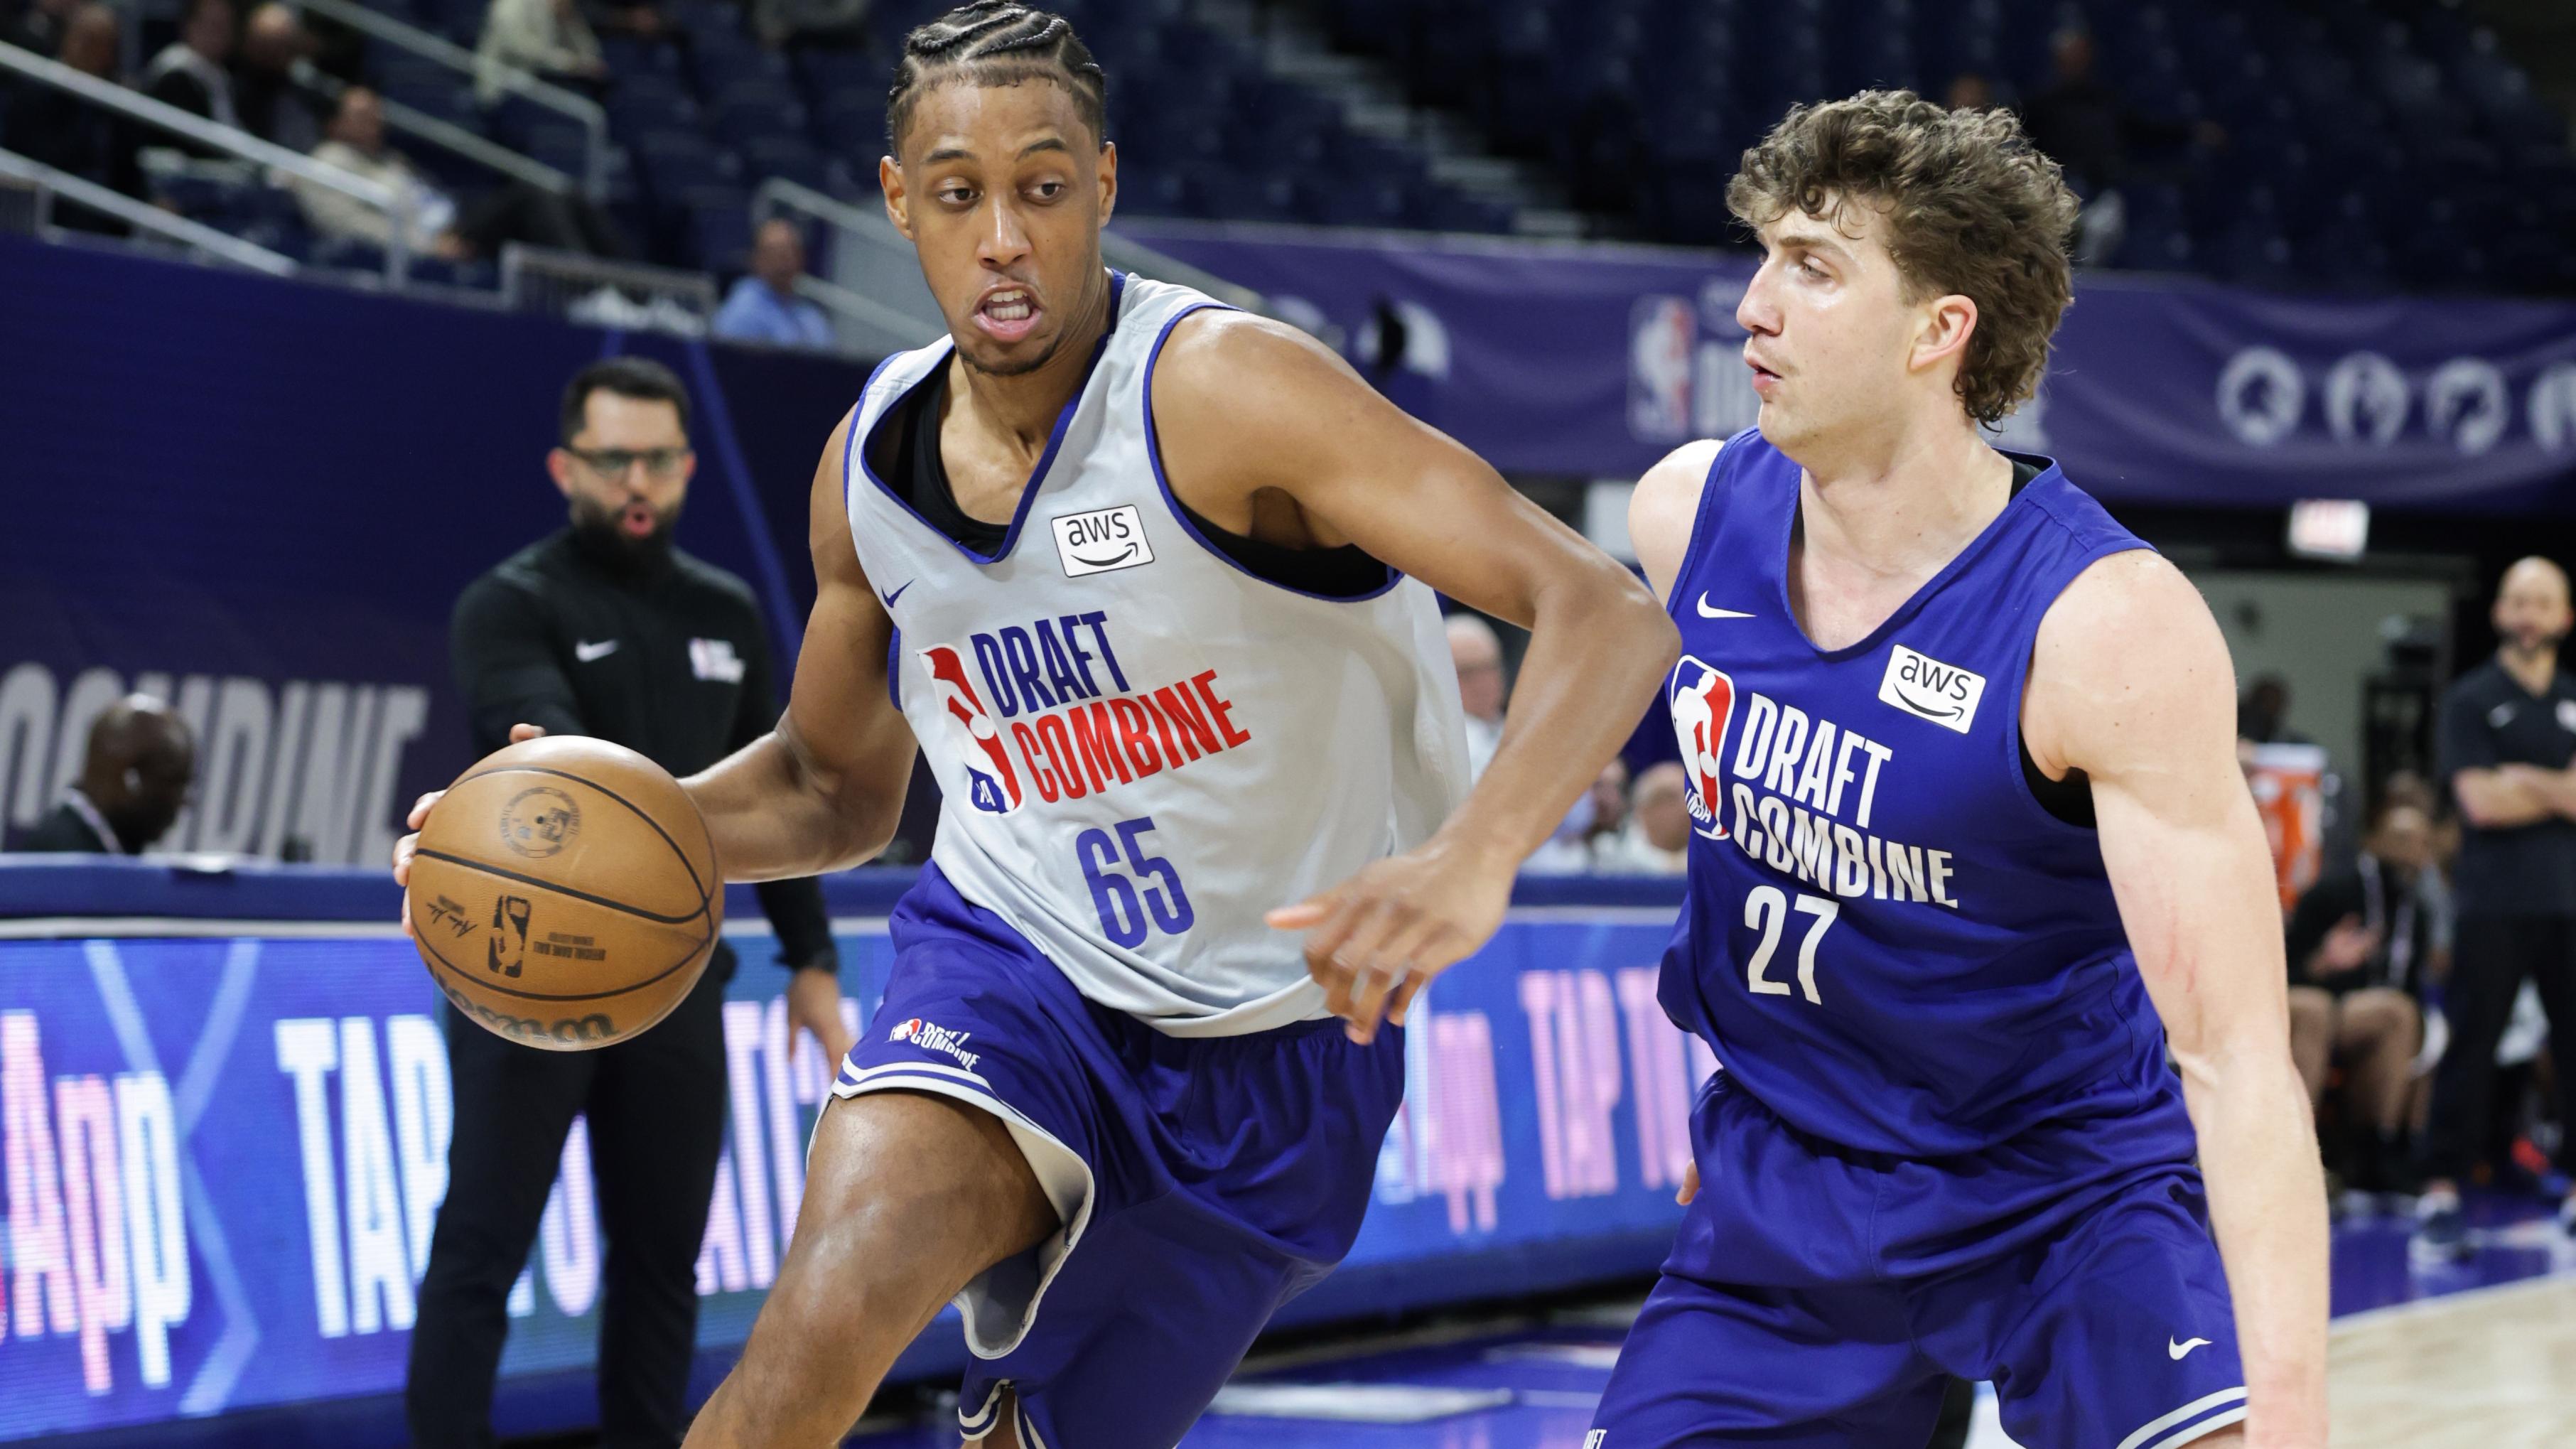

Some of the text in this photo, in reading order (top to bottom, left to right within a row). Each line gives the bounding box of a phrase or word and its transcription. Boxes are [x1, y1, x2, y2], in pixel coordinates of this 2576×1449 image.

[1066, 511, 1131, 546] aws
[969, 610, 1131, 718] DRAFT
[1899, 654, 1973, 701] aws
[1011, 668, 1252, 804] COMBINE
[1732, 692, 1893, 829] DRAFT
[1075, 816, 1195, 950] 65
[1732, 782, 1959, 909] COMBINE
[1744, 885, 1841, 1006] 27
[1582, 1428, 1607, 1449] AFT
